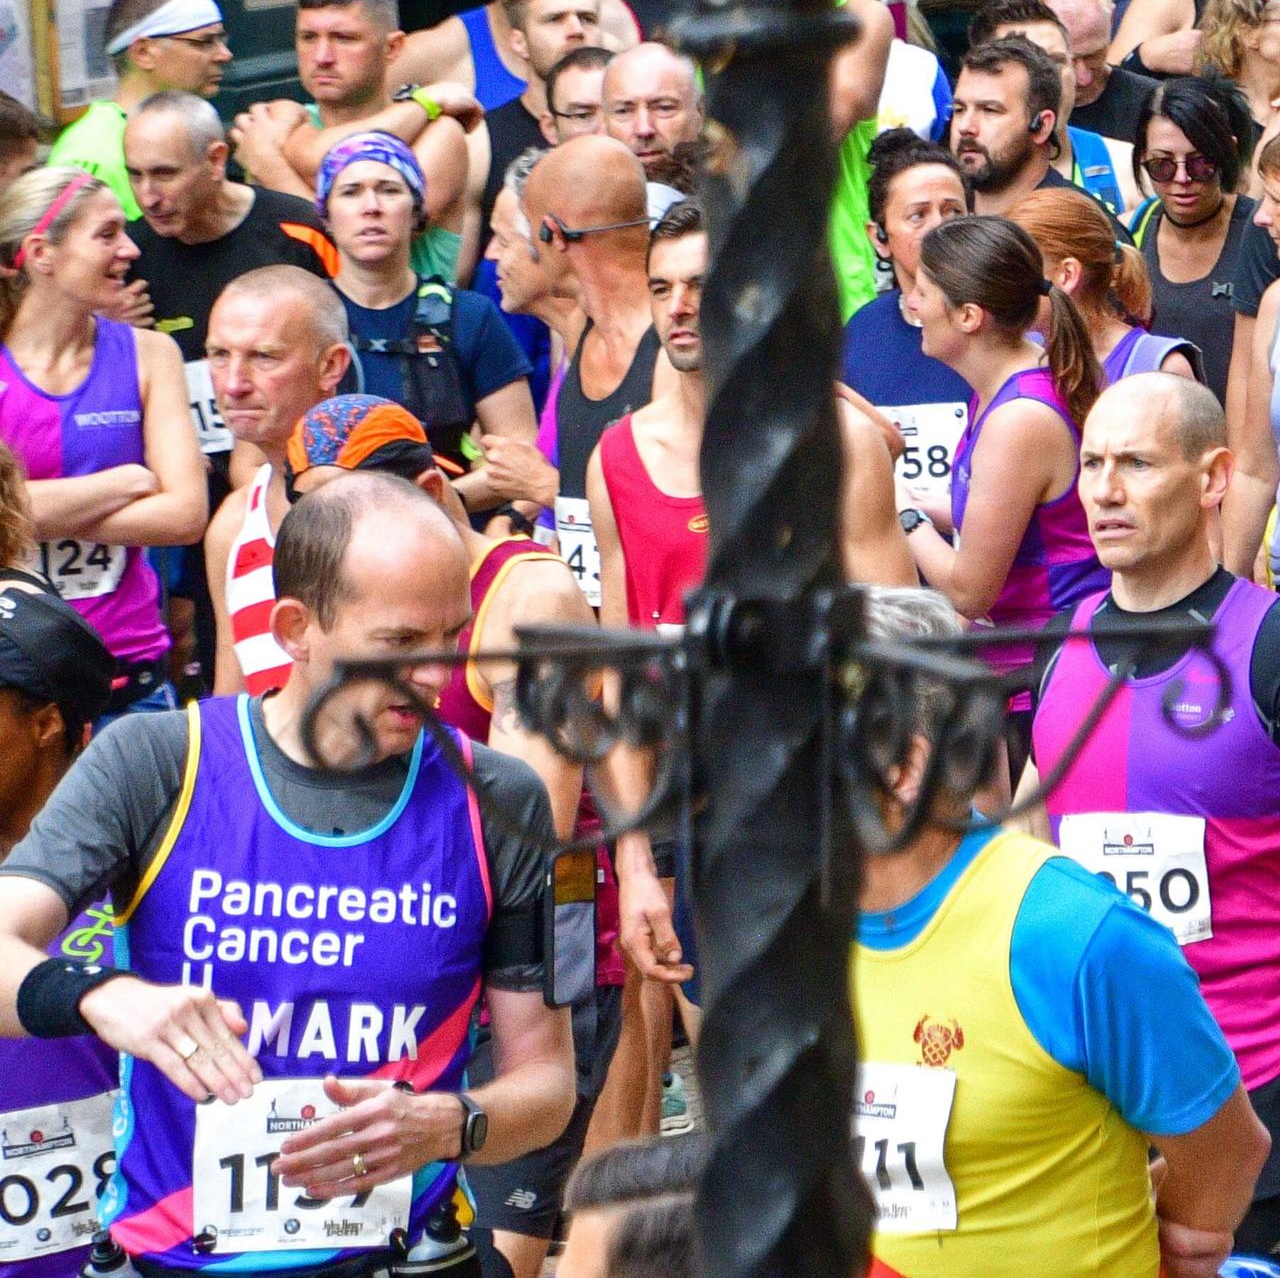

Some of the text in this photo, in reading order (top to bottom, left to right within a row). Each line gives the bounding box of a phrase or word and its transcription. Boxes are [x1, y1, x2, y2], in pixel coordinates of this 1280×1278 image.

[189, 870, 457, 927] Pancreatic
[183, 916, 365, 965] Cancer
[247, 1001, 426, 1062] MARK
